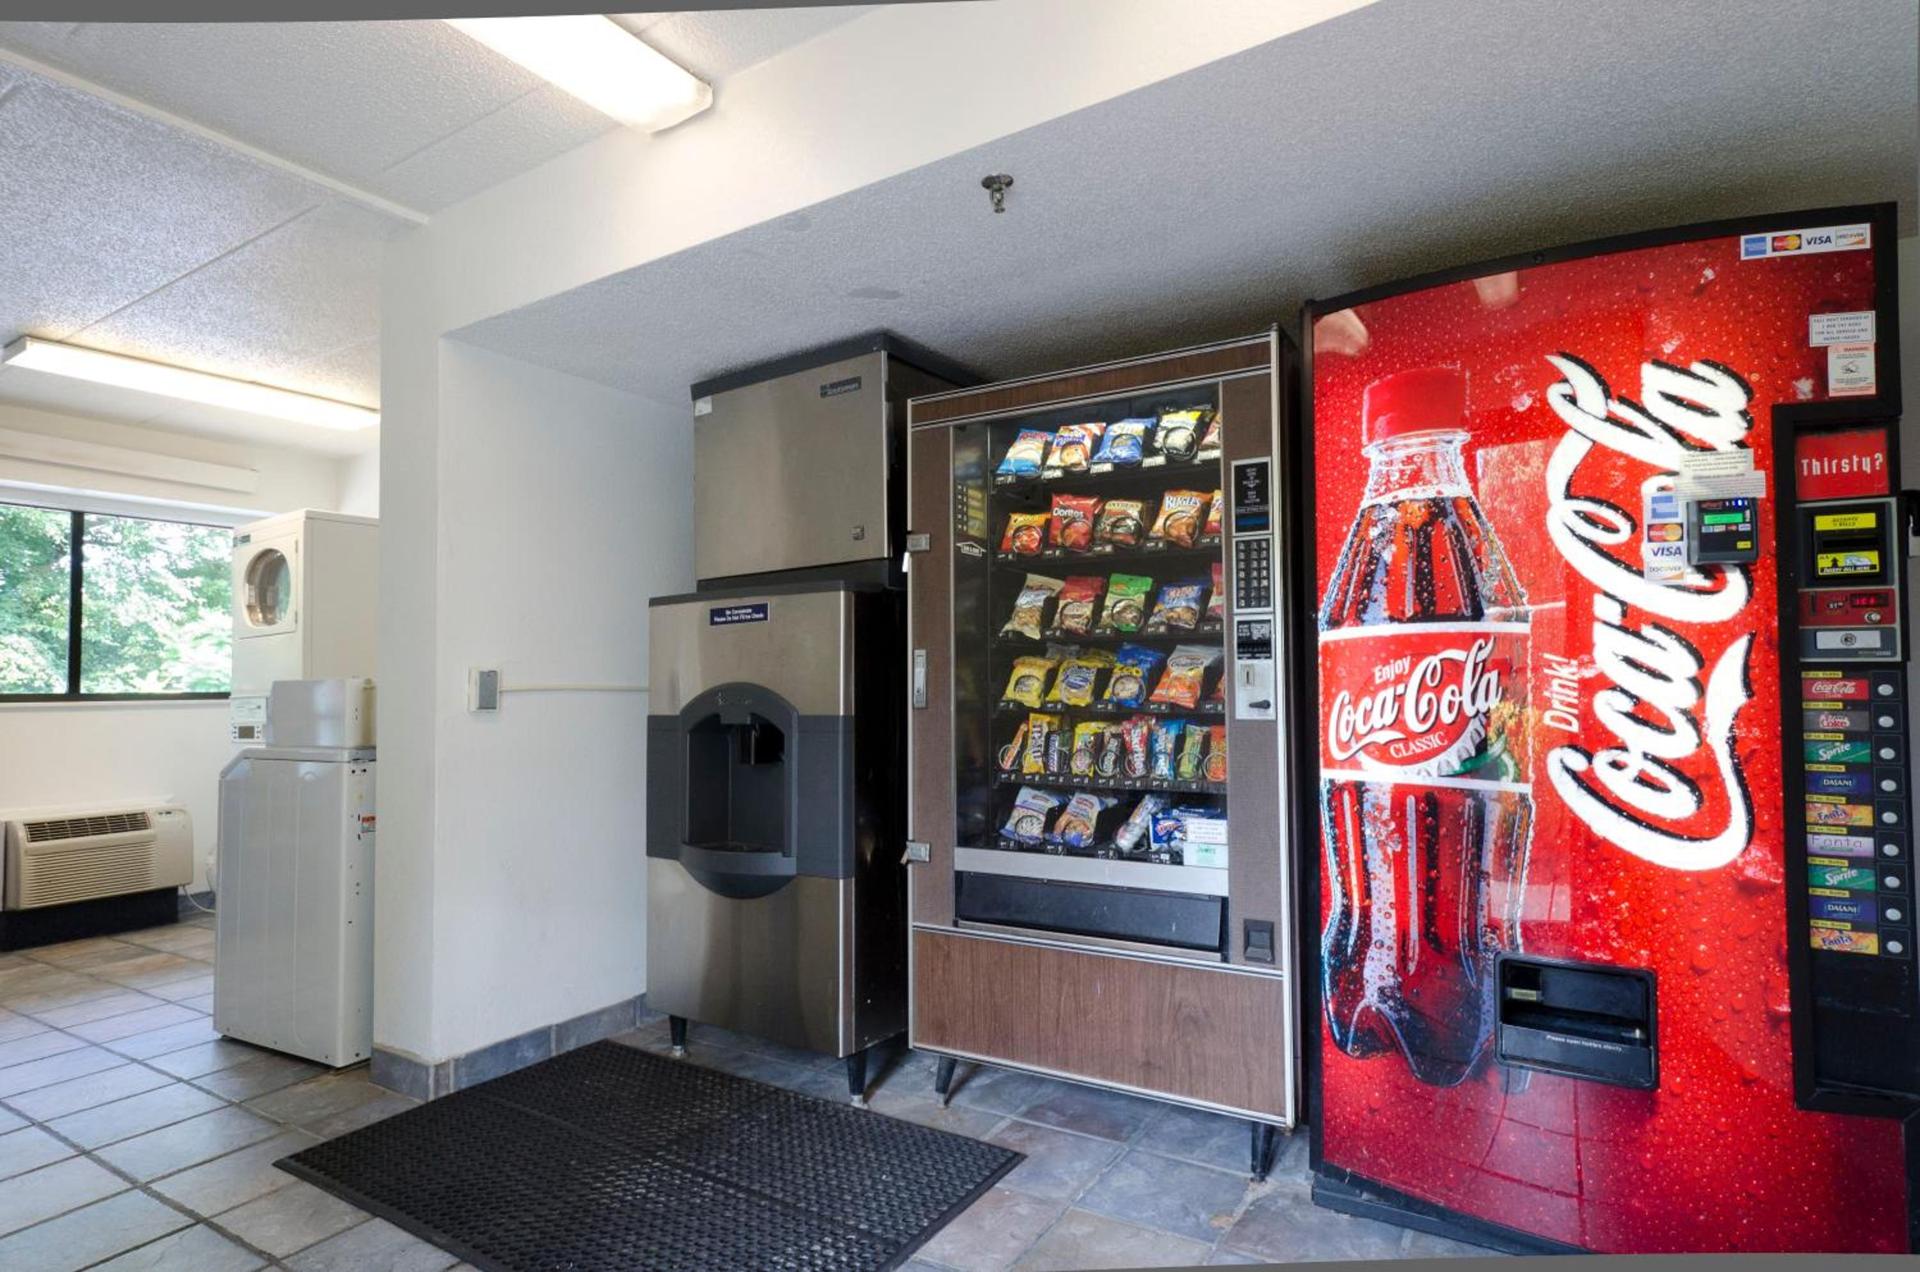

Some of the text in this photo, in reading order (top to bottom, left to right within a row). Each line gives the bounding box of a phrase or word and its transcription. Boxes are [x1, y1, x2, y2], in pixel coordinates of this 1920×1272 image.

[1806, 235, 1832, 246] VISA
[1801, 452, 1883, 477] Thirsty?
[1052, 507, 1085, 519] Doritos
[1651, 546, 1683, 557] VISA
[1545, 350, 1754, 871] Coca-Cola
[1374, 655, 1411, 685] Enjoy
[1542, 652, 1580, 733] Drink!
[1812, 681, 1856, 694] Coca-Cola
[1328, 635, 1502, 761] Coca-Cola
[1389, 731, 1449, 759] CLASSIC
[1818, 742, 1851, 761] Sprite
[1823, 778, 1852, 787] DASANI
[1817, 807, 1848, 820] Fanta
[1812, 834, 1863, 849] Fanta
[1825, 869, 1858, 886] Sprite
[1827, 904, 1857, 914] DASANI
[1822, 934, 1853, 946] Fanta
